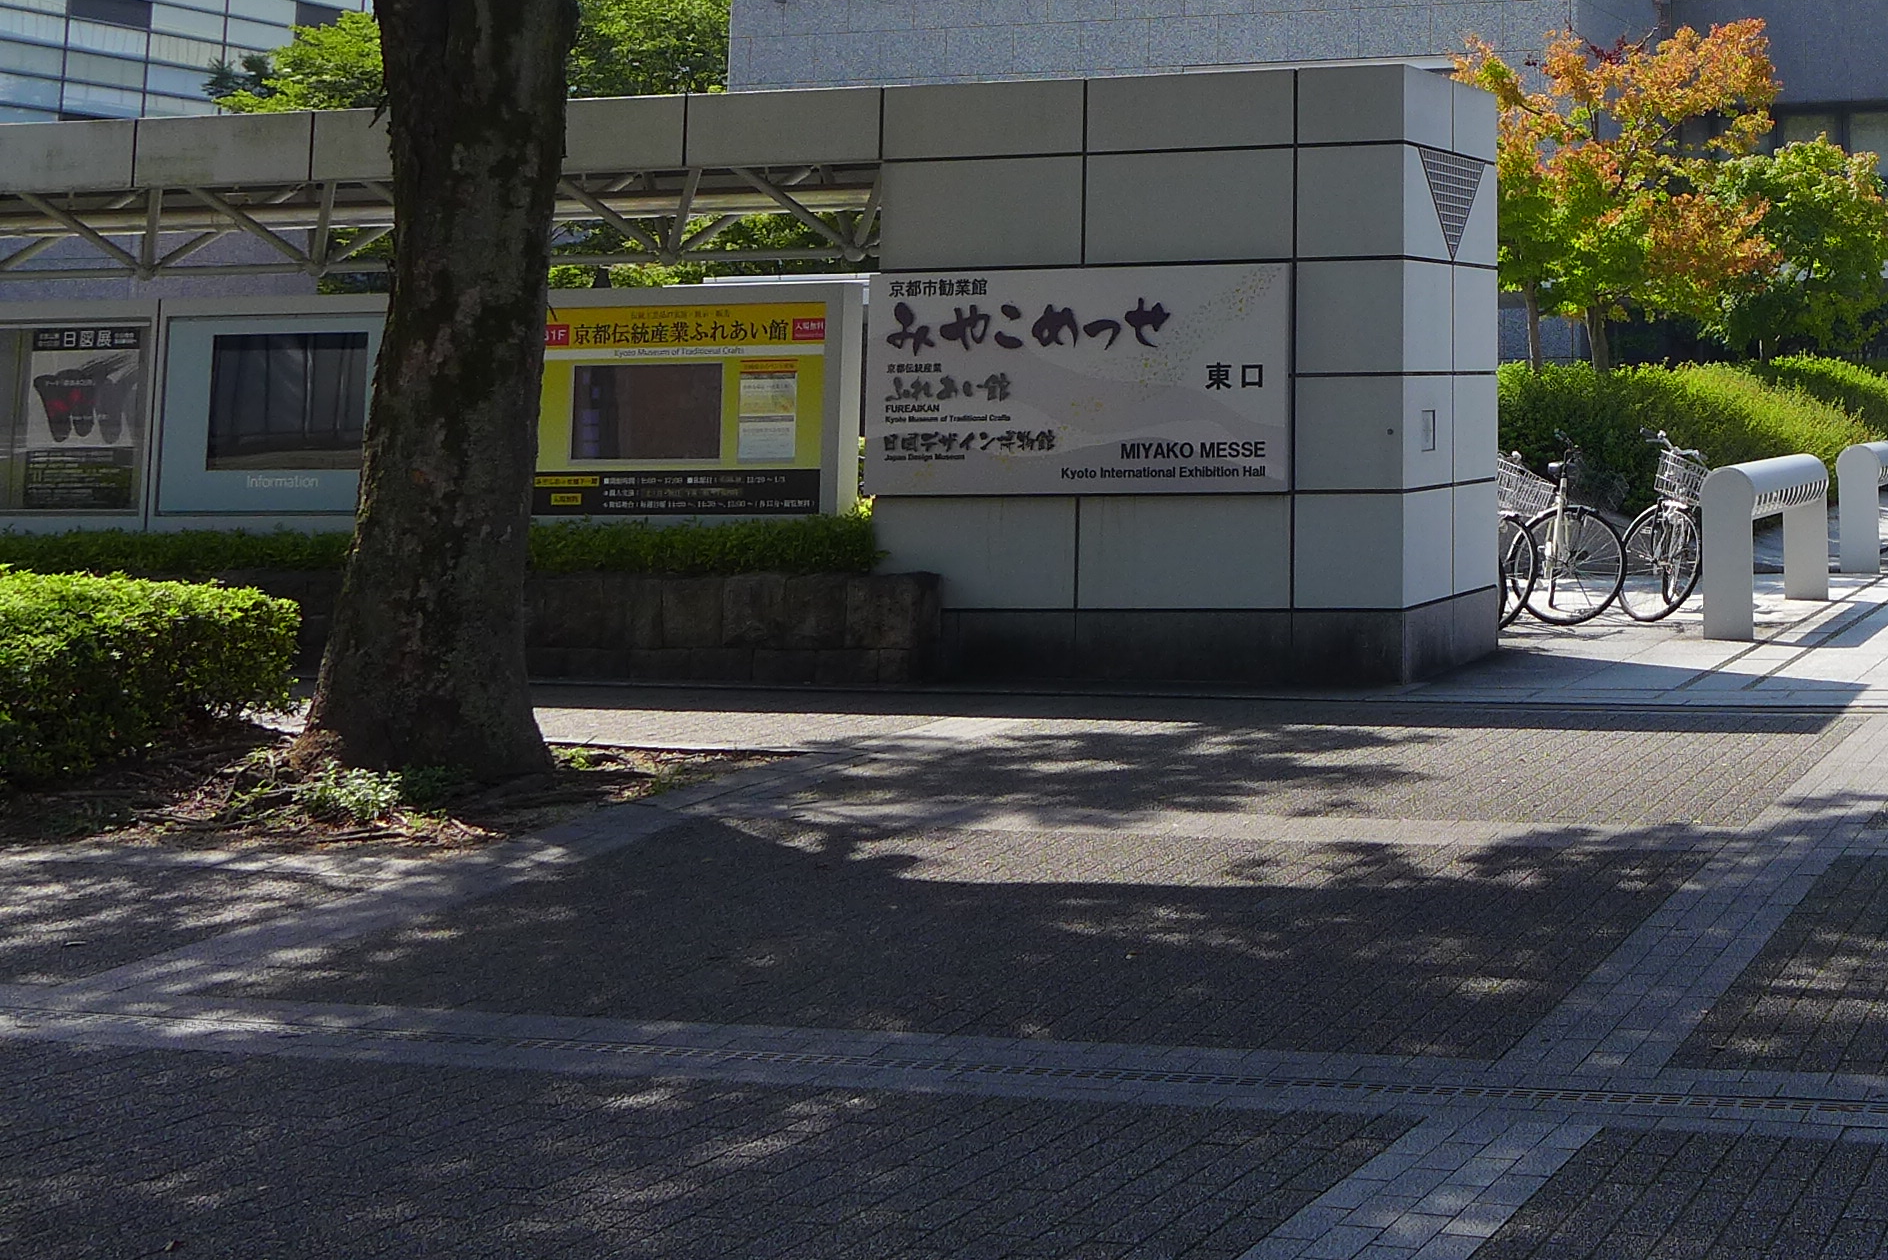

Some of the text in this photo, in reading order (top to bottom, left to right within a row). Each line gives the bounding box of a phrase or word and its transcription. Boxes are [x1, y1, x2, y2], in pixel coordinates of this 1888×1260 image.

[888, 278, 988, 297] 京都市勧業館
[573, 319, 790, 345] 京都伝統産業ふれあい館
[886, 297, 1171, 356] みやこめっせ
[637, 348, 670, 357] Museum
[671, 347, 680, 356] of
[722, 345, 745, 355] Crafts
[1204, 361, 1264, 391] 東口
[885, 404, 940, 413] FUREAIKAN
[908, 415, 939, 423] Museum
[940, 414, 948, 422] of
[950, 414, 988, 422] Traditional
[989, 414, 1011, 422] Crafts
[885, 453, 966, 463] Japan Design Museum
[1120, 441, 1266, 460] MIYAKO MESSE
[1061, 465, 1266, 480] Kyoto International Exhibition Hall
[246, 474, 319, 489] Information
